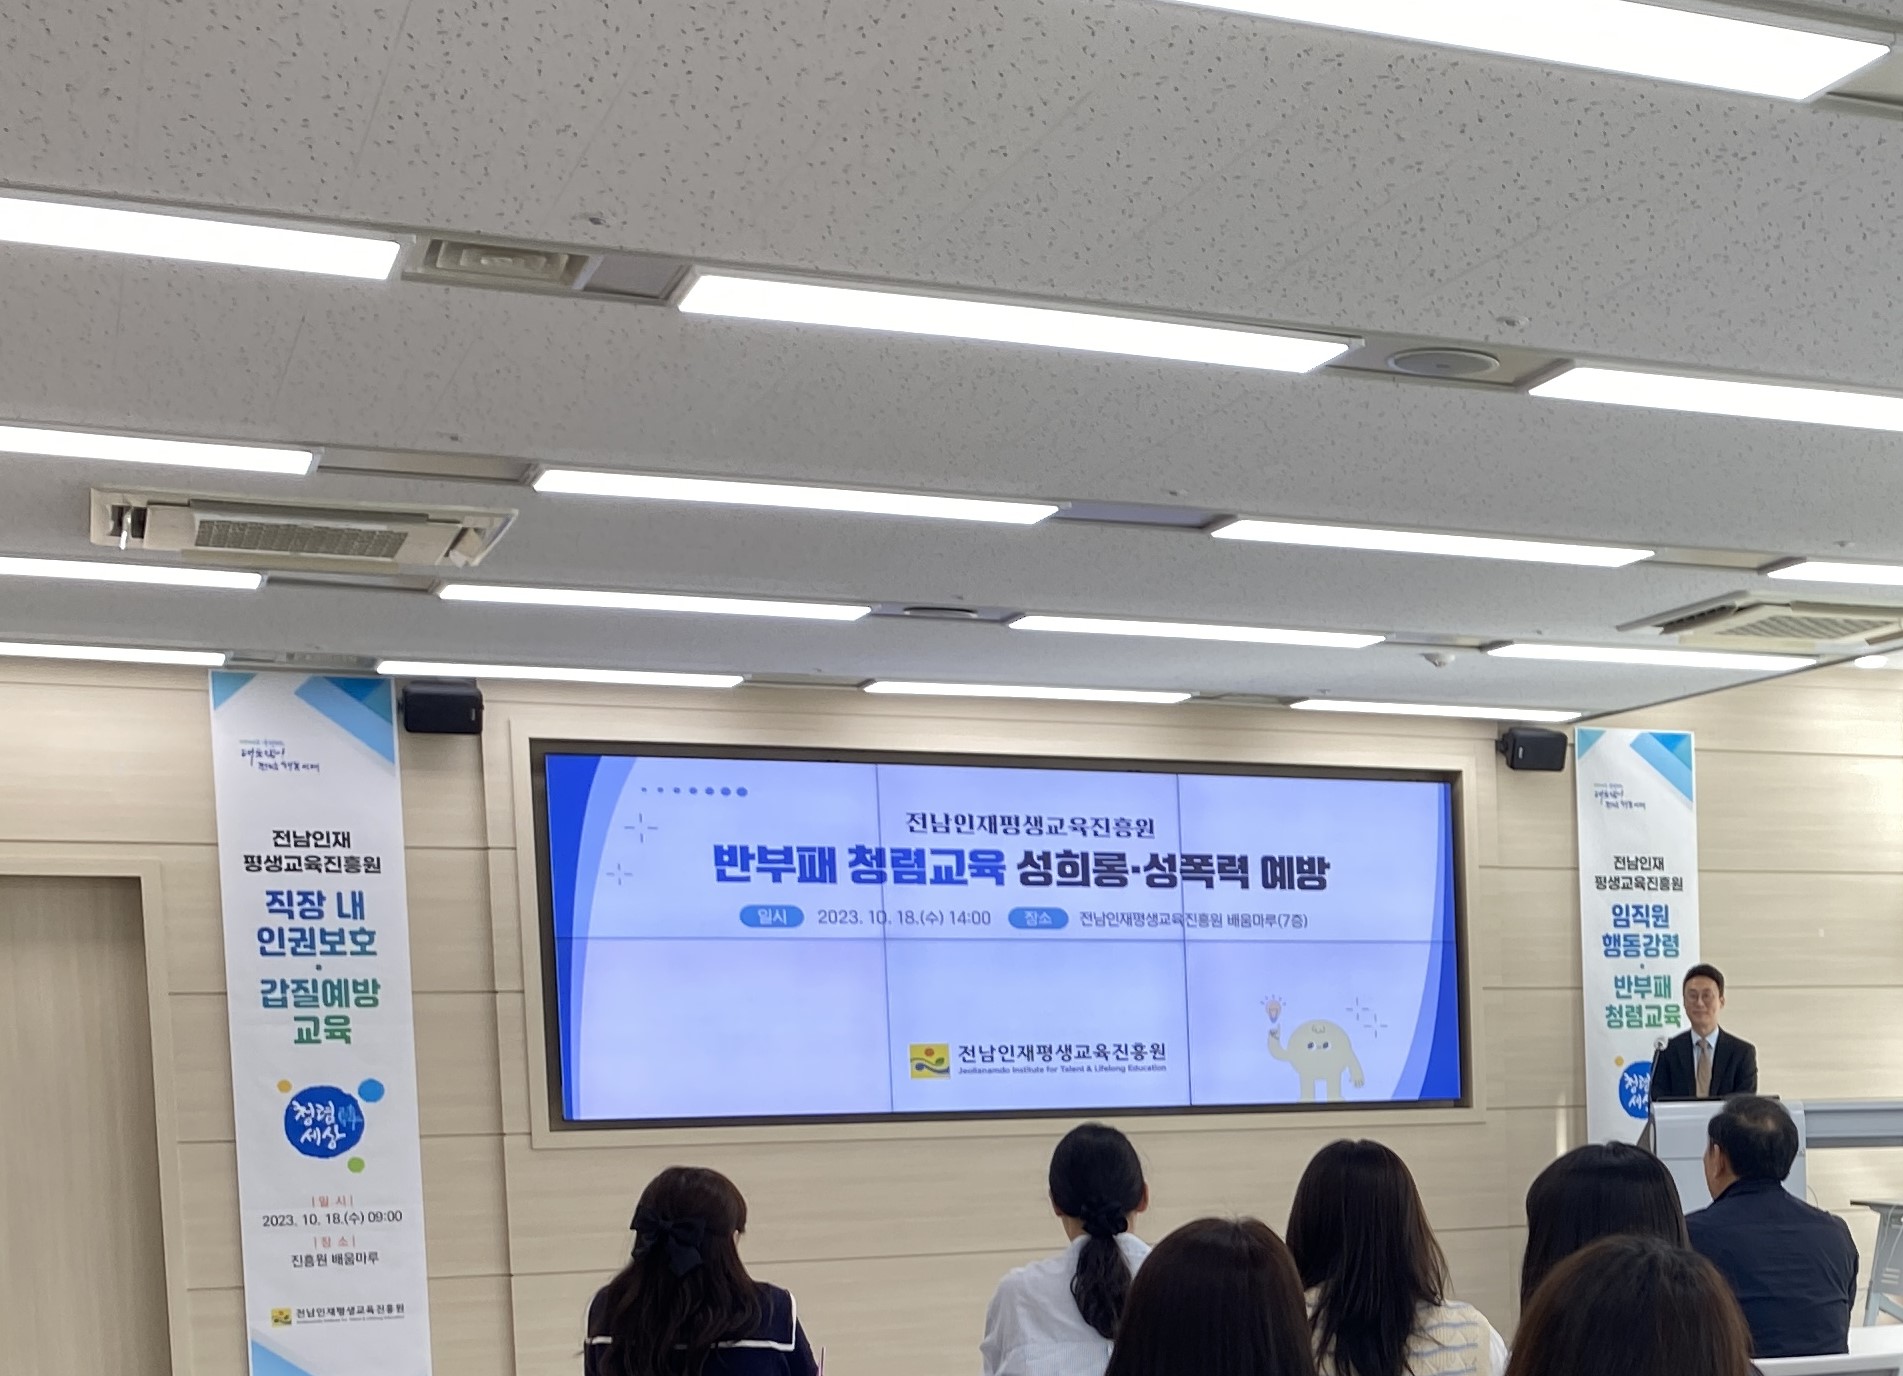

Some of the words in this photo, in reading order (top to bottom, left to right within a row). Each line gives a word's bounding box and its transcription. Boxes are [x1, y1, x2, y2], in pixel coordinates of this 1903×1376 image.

[905, 811, 1156, 840] 전남인재평생교육진흥원
[272, 829, 352, 849] 전남인재
[243, 854, 382, 874] 평생교육진흥원
[712, 843, 838, 885] 반부패
[847, 845, 1007, 887] 청렴교육
[1016, 849, 1251, 890] 성희롱·성폭력
[1260, 854, 1331, 891] 예방
[1613, 855, 1665, 872] 전남인재
[1594, 874, 1684, 892] 평생교육진흥원
[265, 889, 327, 921] 직장
[336, 889, 365, 921] 내
[756, 908, 788, 926] 일시
[1611, 902, 1670, 929] 임직원
[817, 909, 864, 926] 2023.
[868, 909, 892, 926] 10.
[949, 909, 992, 926] 14:00
[1078, 910, 1223, 929] 전남인재평생교육진흥원
[256, 925, 378, 957] 인권보호
[1602, 932, 1680, 959] 행동강령
[260, 977, 381, 1009] 갑질예방
[1614, 974, 1672, 1000] 반부패
[1605, 1003, 1682, 1030] 청렴교육
[293, 1014, 352, 1045] 교육
[957, 1042, 1168, 1064] 전남인재평생교육진흥원
[1046, 1064, 1058, 1074] for
[291, 1100, 336, 1127] 청렴
[300, 1123, 347, 1151] 세상
[262, 1213, 298, 1228] 2023.
[303, 1212, 321, 1226] 10.
[367, 1209, 403, 1223] 09:00
[291, 1253, 328, 1269] 진흥원
[331, 1250, 380, 1266] 배움마루
[296, 1303, 405, 1319] 전남인재평생교육진흥원
